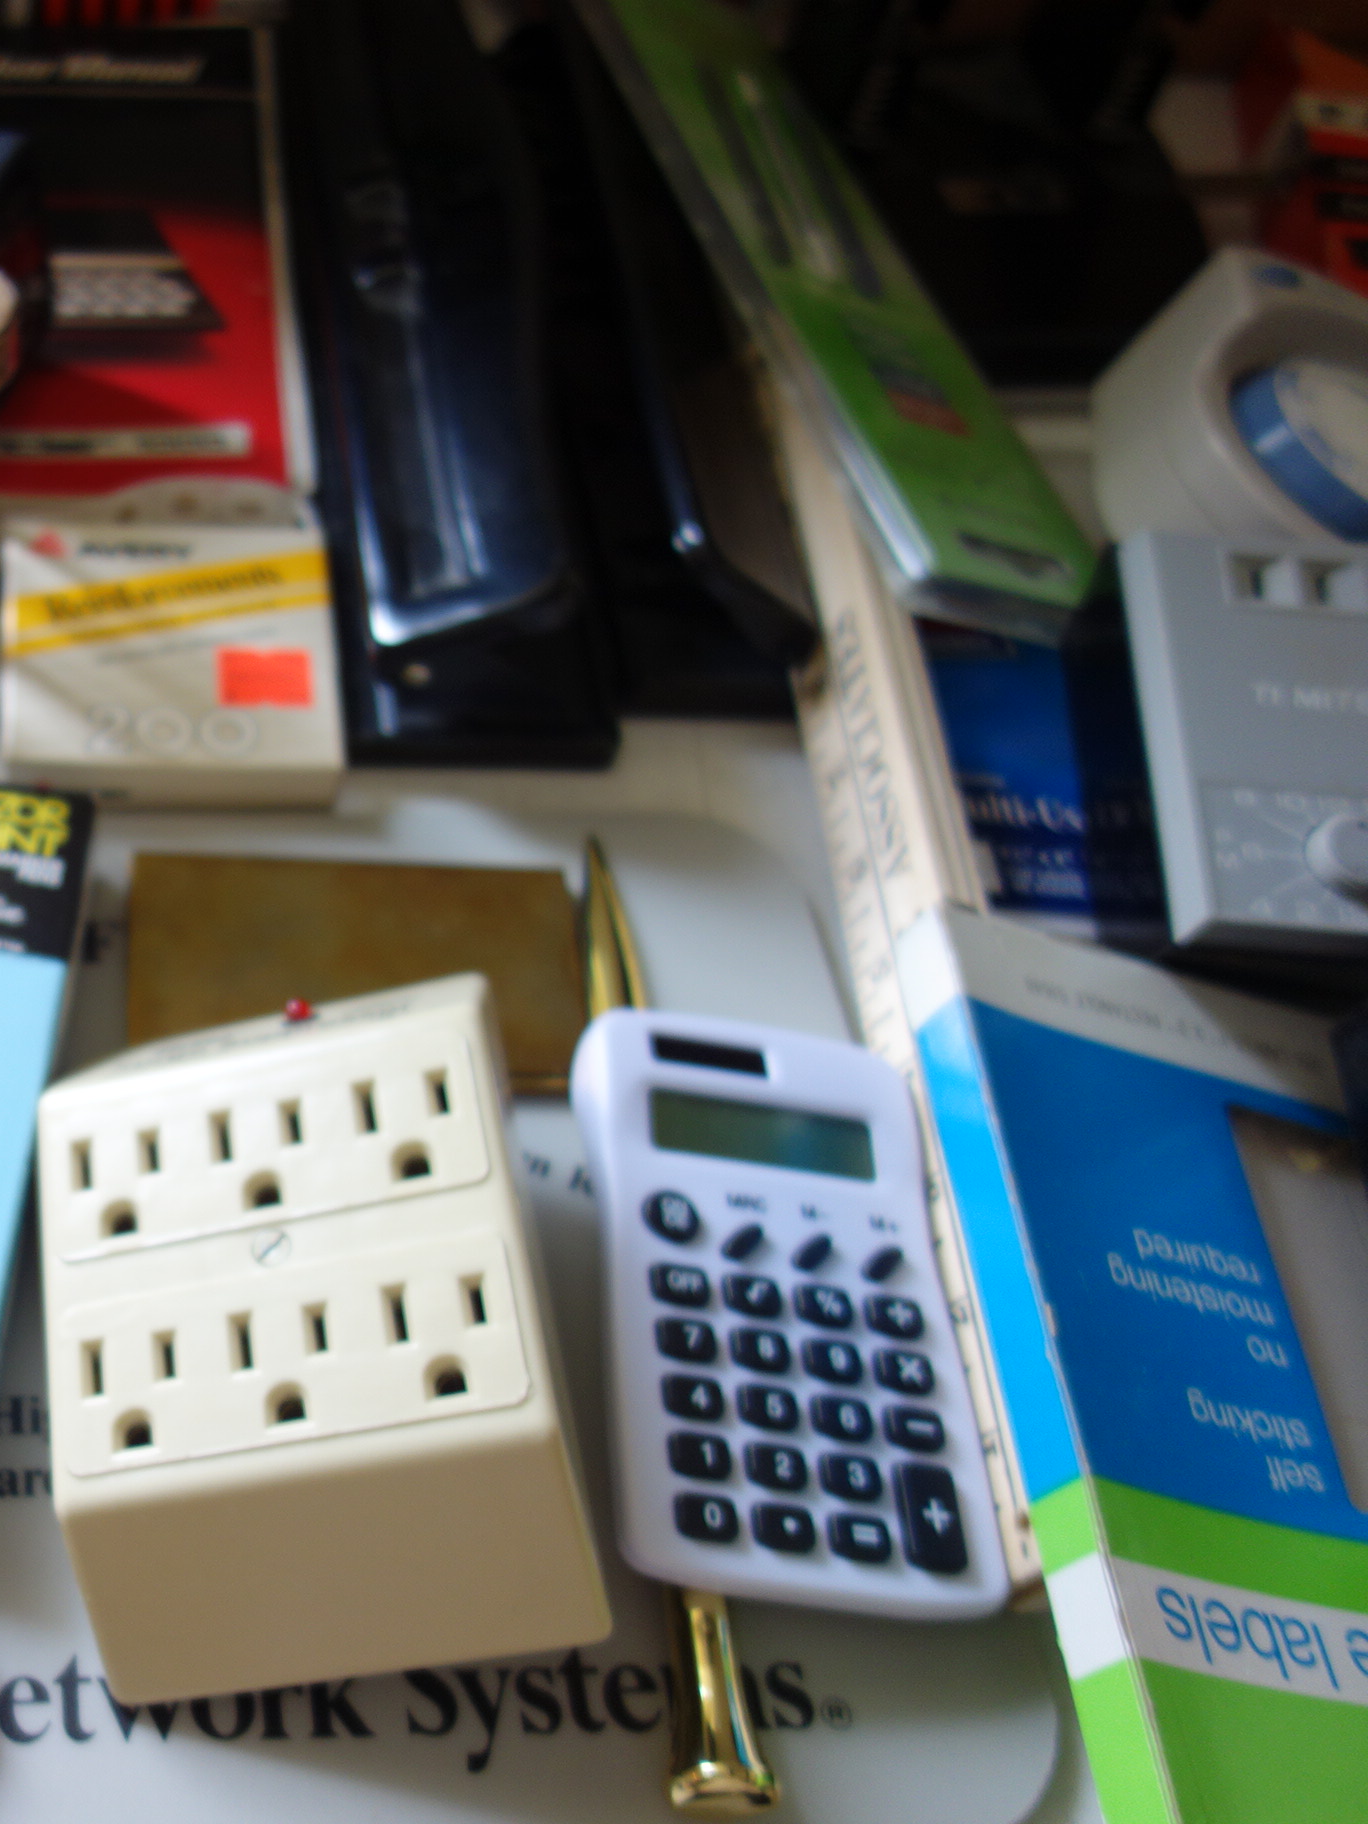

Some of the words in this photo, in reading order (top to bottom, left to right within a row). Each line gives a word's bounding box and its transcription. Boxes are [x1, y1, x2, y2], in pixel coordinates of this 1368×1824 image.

[1131, 1229, 1263, 1287] required
[666, 1271, 703, 1294] OFF
[1106, 1251, 1277, 1328] moistening
[683, 1326, 705, 1350] 7
[1244, 1334, 1291, 1369] no
[689, 1384, 710, 1411] 4
[1185, 1387, 1313, 1453] sticking
[775, 1452, 794, 1480] 2
[1263, 1455, 1329, 1496] self
[702, 1500, 725, 1531] 0
[1155, 1584, 1340, 1692] labels
